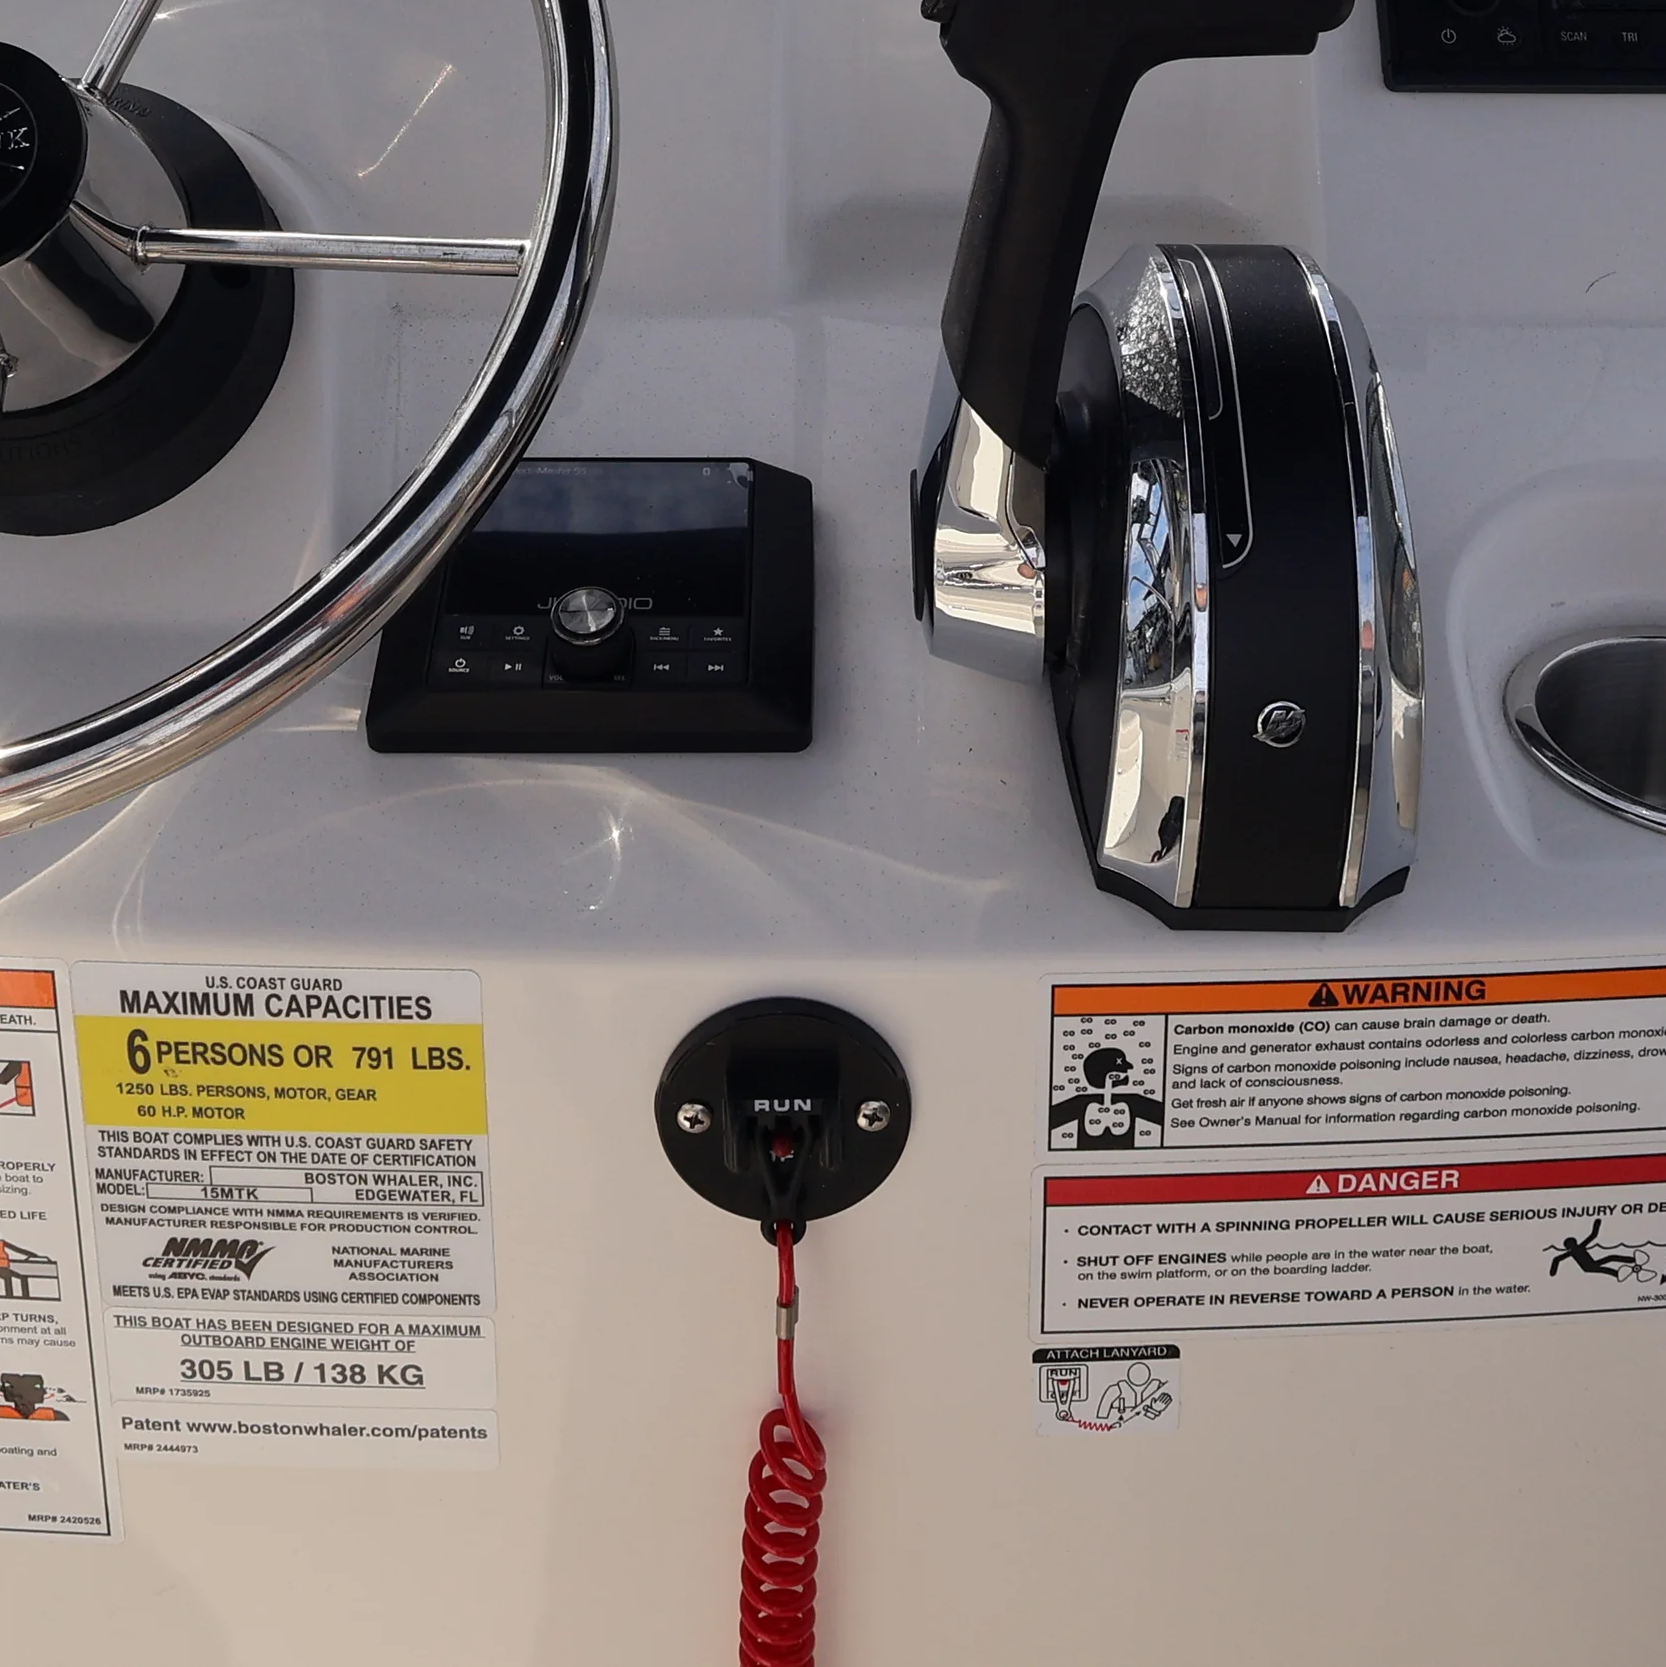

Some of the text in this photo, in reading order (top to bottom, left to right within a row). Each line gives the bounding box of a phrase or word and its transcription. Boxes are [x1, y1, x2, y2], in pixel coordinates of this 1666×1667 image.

[1560, 31, 1588, 42] SCAN
[1621, 32, 1638, 42] TRI
[205, 975, 342, 991] U.S. COAST GUARD
[1341, 979, 1485, 1004] WARNING
[119, 989, 431, 1020] MAXIMUM CAPACITIES
[1173, 1012, 1550, 1035] Carbon monoxide (CO) can cause brain damage or death.
[126, 1028, 151, 1074] 6
[156, 1040, 470, 1070] PERSONS OR 791 LBS.
[116, 1082, 376, 1101] 1250 LBS. PERSONS, MOTOR, GEAR
[137, 1104, 245, 1119] 60 H.P. MOTOR
[754, 1099, 812, 1112] RUN
[97, 1129, 472, 1150] THIS BOAT COMPLIES WITH U.S. COAST GUARD SAFETY
[94, 1167, 203, 1182] MANUFACTURER:
[304, 1172, 477, 1188] BOSTON WHALER, INC.
[1337, 1169, 1459, 1192] DANGER
[96, 1184, 146, 1196] MODEL:
[200, 1187, 259, 1200] 15MTK
[355, 1188, 478, 1203] EDGEWATER, FL
[1077, 1223, 1152, 1236] CONTACT
[1156, 1222, 1195, 1233] WITH
[1200, 1222, 1211, 1232] A
[1215, 1219, 1290, 1232] SPINNING
[1294, 1215, 1387, 1229] PROPELLER
[1391, 1214, 1428, 1226] WILL
[1432, 1211, 1485, 1224] CAUSE
[1489, 1207, 1557, 1221] SERIOUS
[1561, 1204, 1617, 1217] INJURY
[1620, 1203, 1643, 1214] OR
[331, 1245, 449, 1256] NATIONAL MARINE
[142, 1257, 233, 1270] CERTIFIED
[333, 1258, 453, 1269] MANUFACTURERS
[348, 1271, 438, 1282] ASSOCIATION
[1046, 1346, 1166, 1359] ATTACH LANYARD
[180, 1358, 423, 1385] 305 LB / 138 KG
[1050, 1368, 1077, 1377] RUN
[135, 1386, 210, 1397] MRP# 1735925
[121, 1416, 487, 1441] Patent www.bostonwhaler.com/patents
[123, 1443, 198, 1453] MRP# 2444973
[27, 1513, 101, 1525] MRP# 2420526
